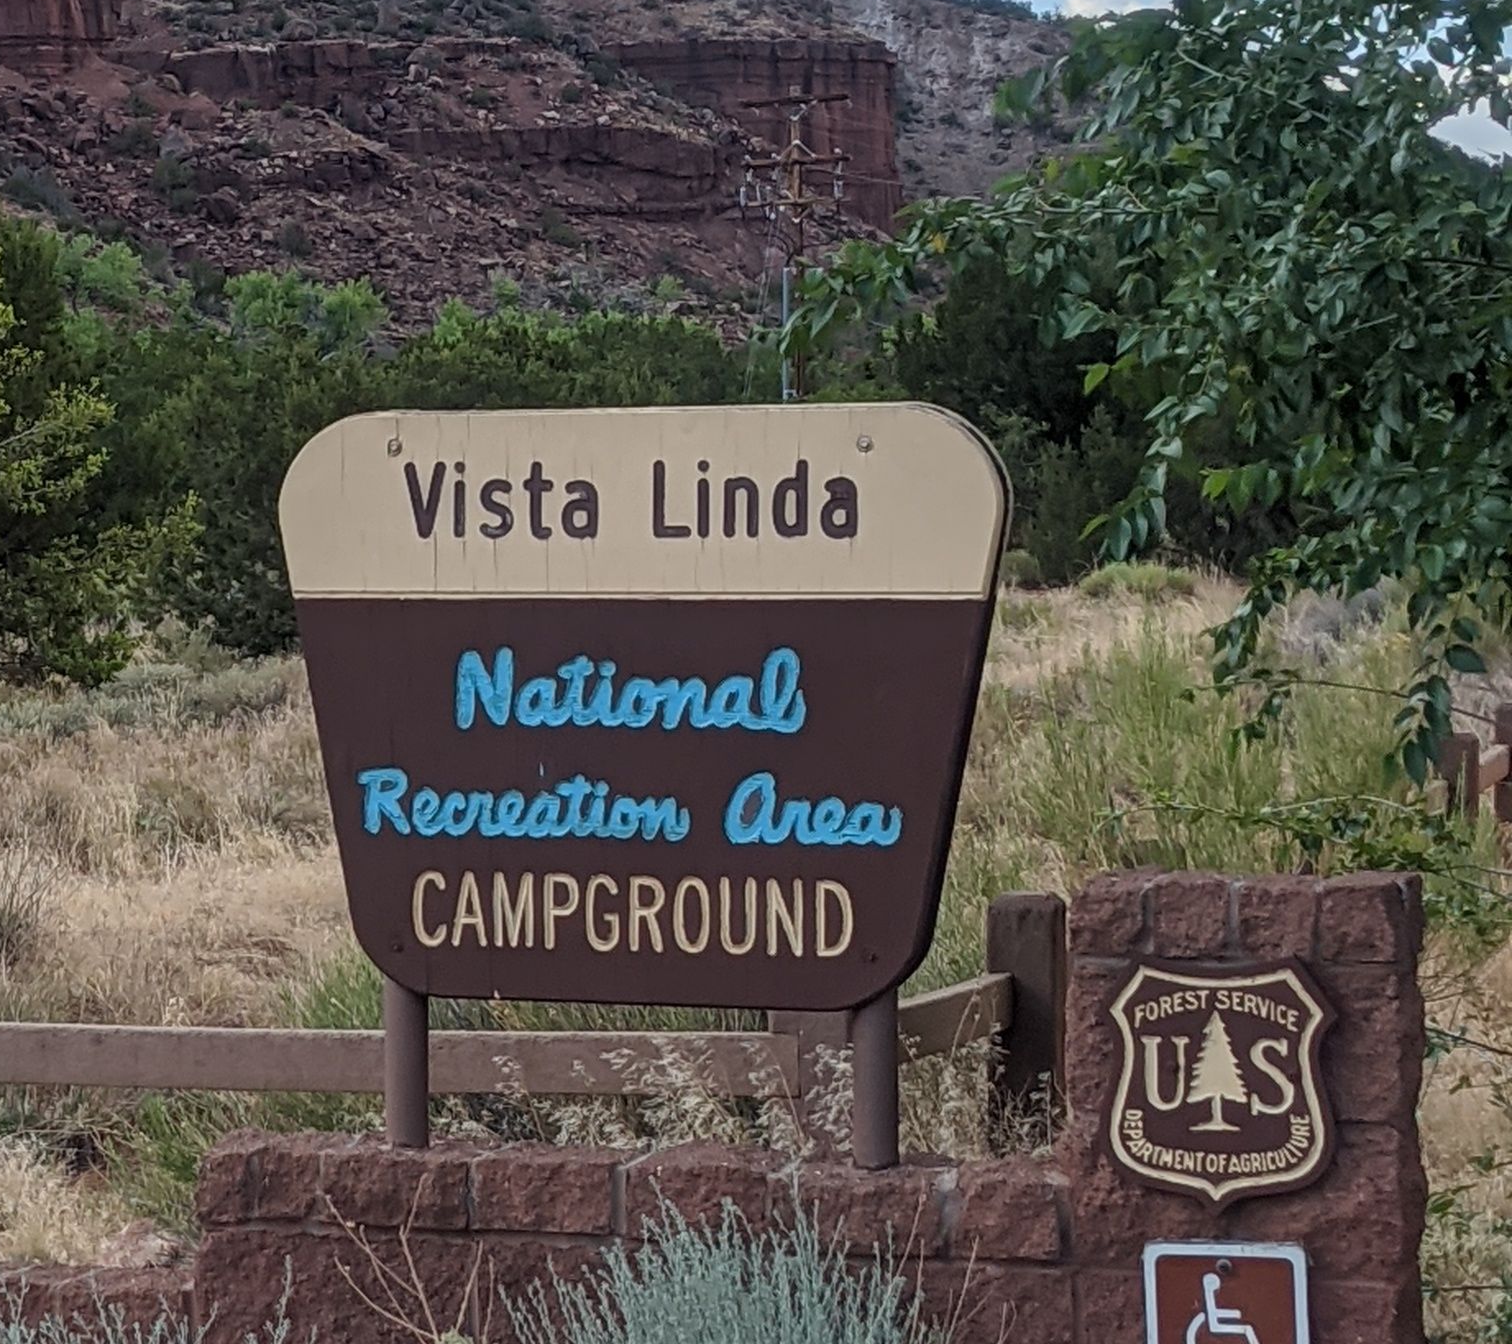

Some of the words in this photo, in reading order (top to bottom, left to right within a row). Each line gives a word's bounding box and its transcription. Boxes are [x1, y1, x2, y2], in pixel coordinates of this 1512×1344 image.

[403, 460, 599, 539] Vista
[652, 459, 859, 539] Linda
[455, 647, 805, 734] National
[357, 768, 689, 841] Recreation
[724, 771, 902, 846] Area
[412, 871, 854, 957] CAMPGROUND
[1134, 990, 1210, 1028] FOREST
[1214, 990, 1299, 1032] SERVICE
[1140, 1035, 1191, 1111] U
[1250, 1038, 1295, 1116] S
[1123, 1109, 1205, 1172] DEPARTMENT
[1205, 1154, 1228, 1173] OF
[1228, 1114, 1311, 1173] AGRICULTURE
